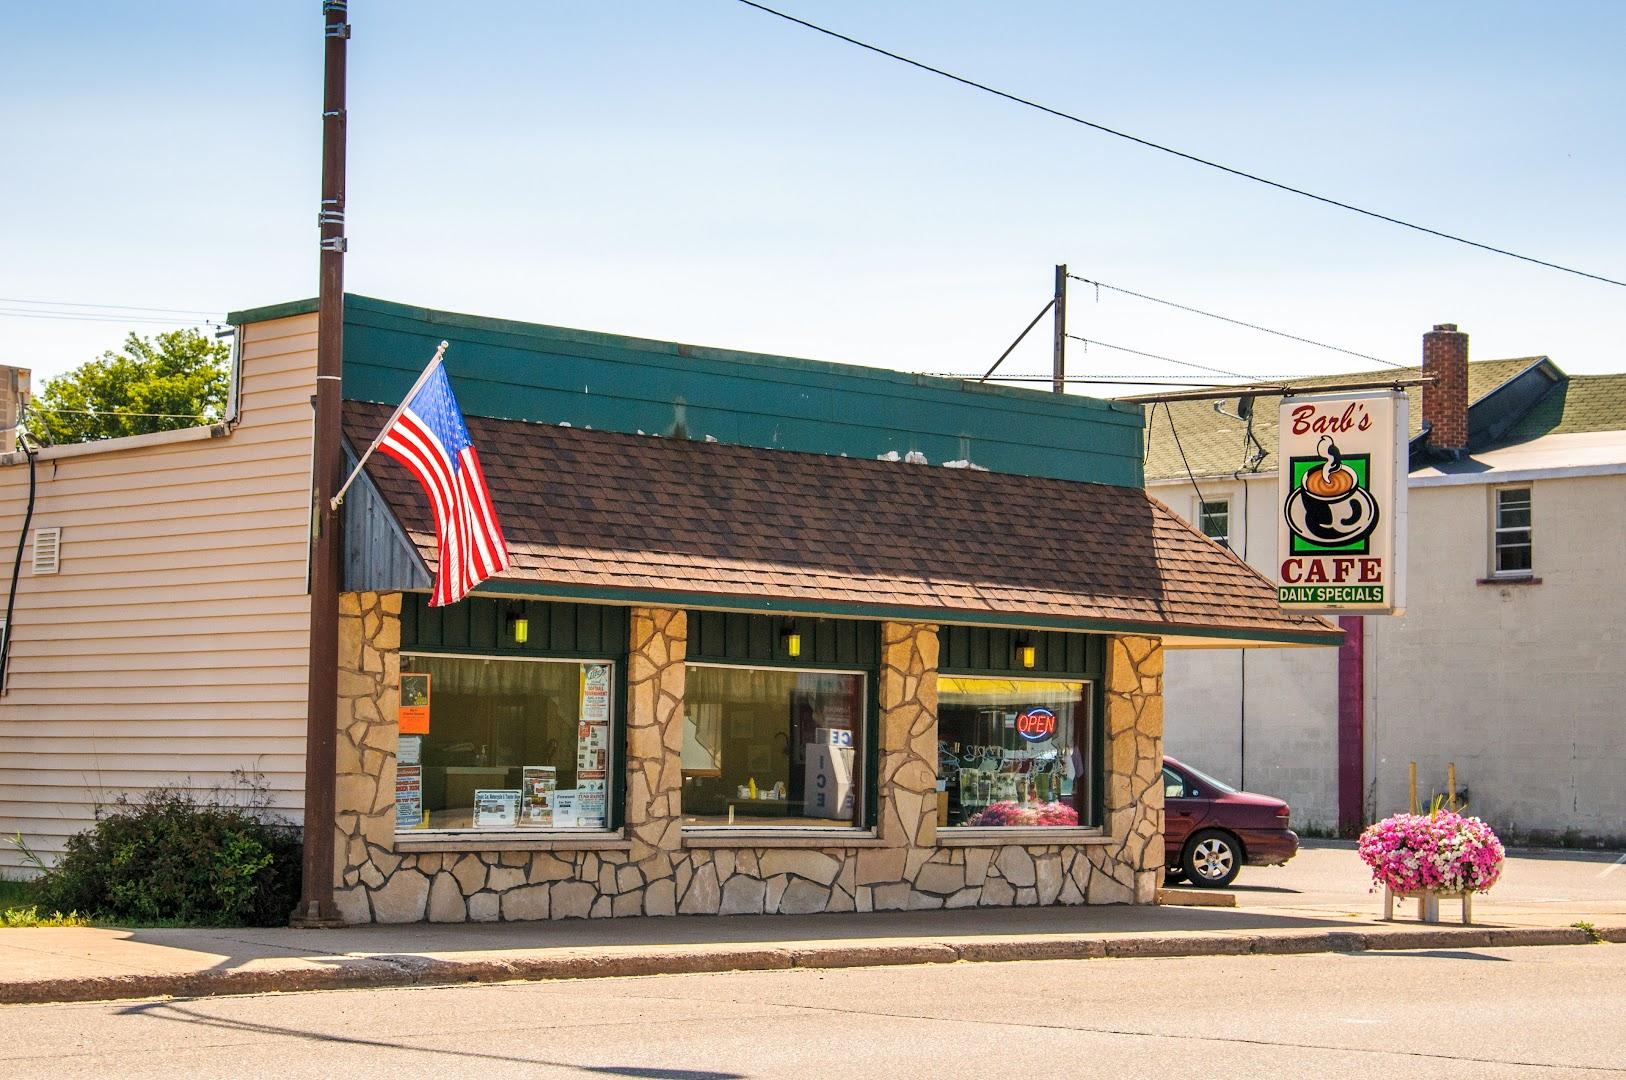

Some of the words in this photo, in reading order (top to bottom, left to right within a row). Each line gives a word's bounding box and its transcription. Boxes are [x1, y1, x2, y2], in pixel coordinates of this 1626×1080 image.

[1291, 402, 1373, 436] Barb's
[1280, 557, 1382, 584] CAFE
[1279, 587, 1314, 602] DAILY
[1316, 586, 1382, 602] SPECIALS
[1017, 715, 1056, 733] OPEN
